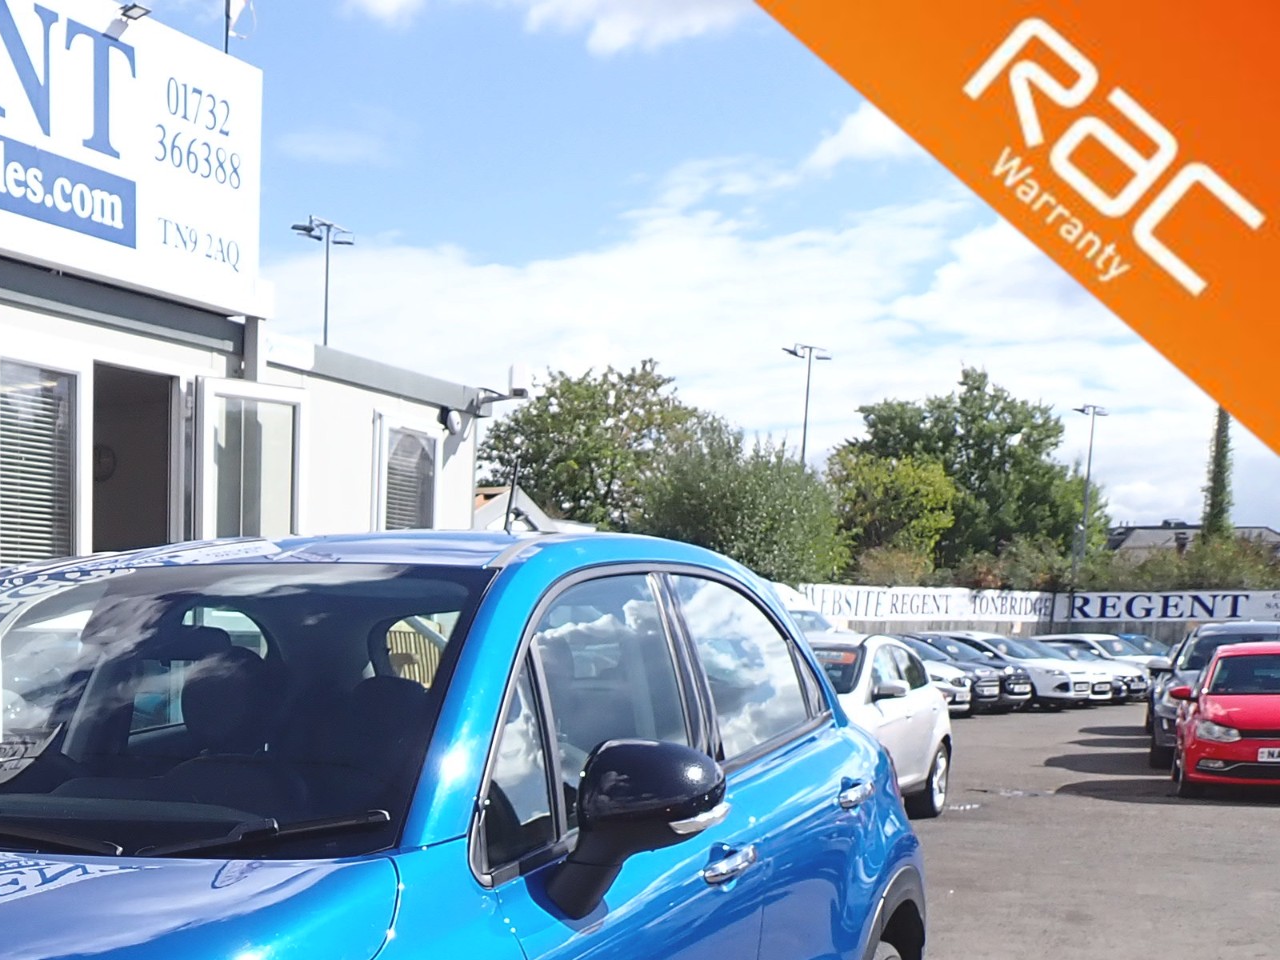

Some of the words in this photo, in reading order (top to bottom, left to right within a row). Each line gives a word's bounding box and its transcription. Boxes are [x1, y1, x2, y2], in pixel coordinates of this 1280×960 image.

[166, 76, 231, 137] 01732
[154, 123, 241, 190] 366388
[157, 216, 198, 253] TN9
[205, 233, 240, 273] 2AQ
[889, 593, 952, 615] REGENT
[971, 594, 1052, 617] TONBRIDGE
[1064, 593, 1250, 619] REGENT
